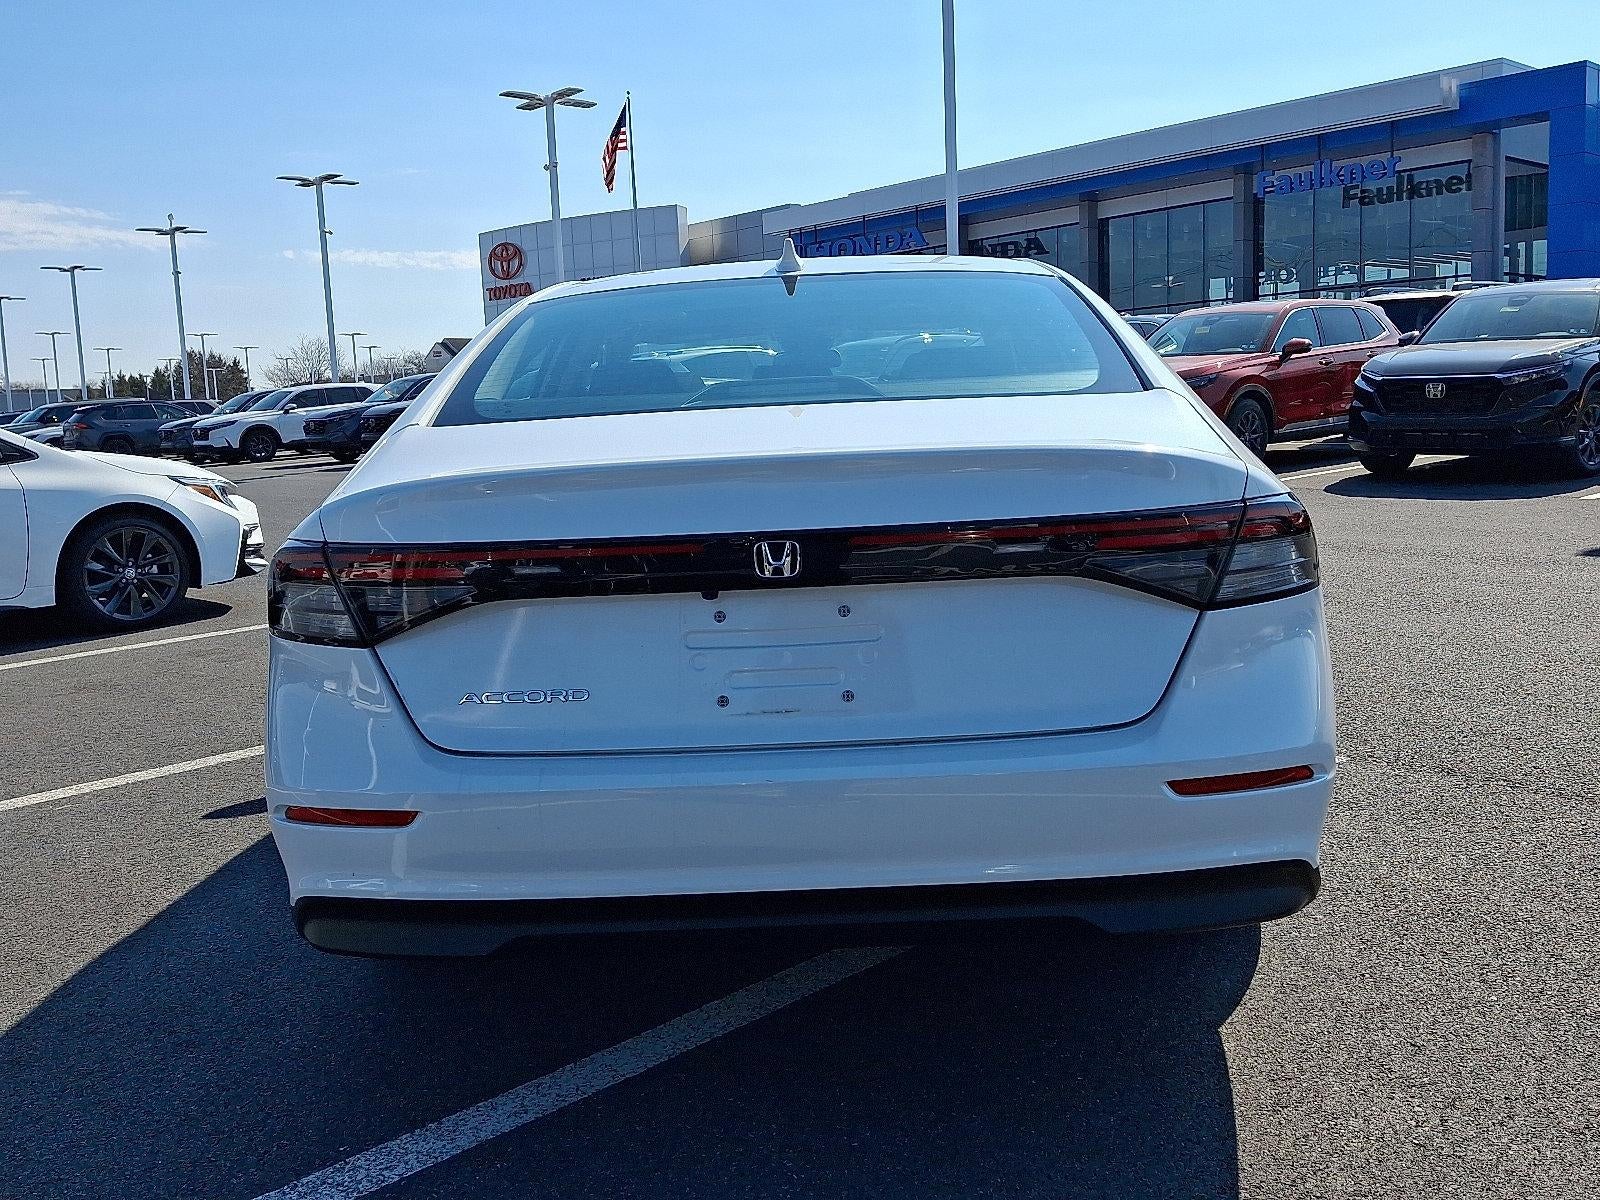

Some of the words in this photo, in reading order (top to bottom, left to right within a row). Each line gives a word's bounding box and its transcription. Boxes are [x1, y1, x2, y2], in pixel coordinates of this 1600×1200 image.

[1256, 155, 1402, 198] Faulkner
[806, 227, 928, 257] HONDA
[486, 282, 533, 301] TOYOTA
[458, 688, 591, 706] ACCORD
